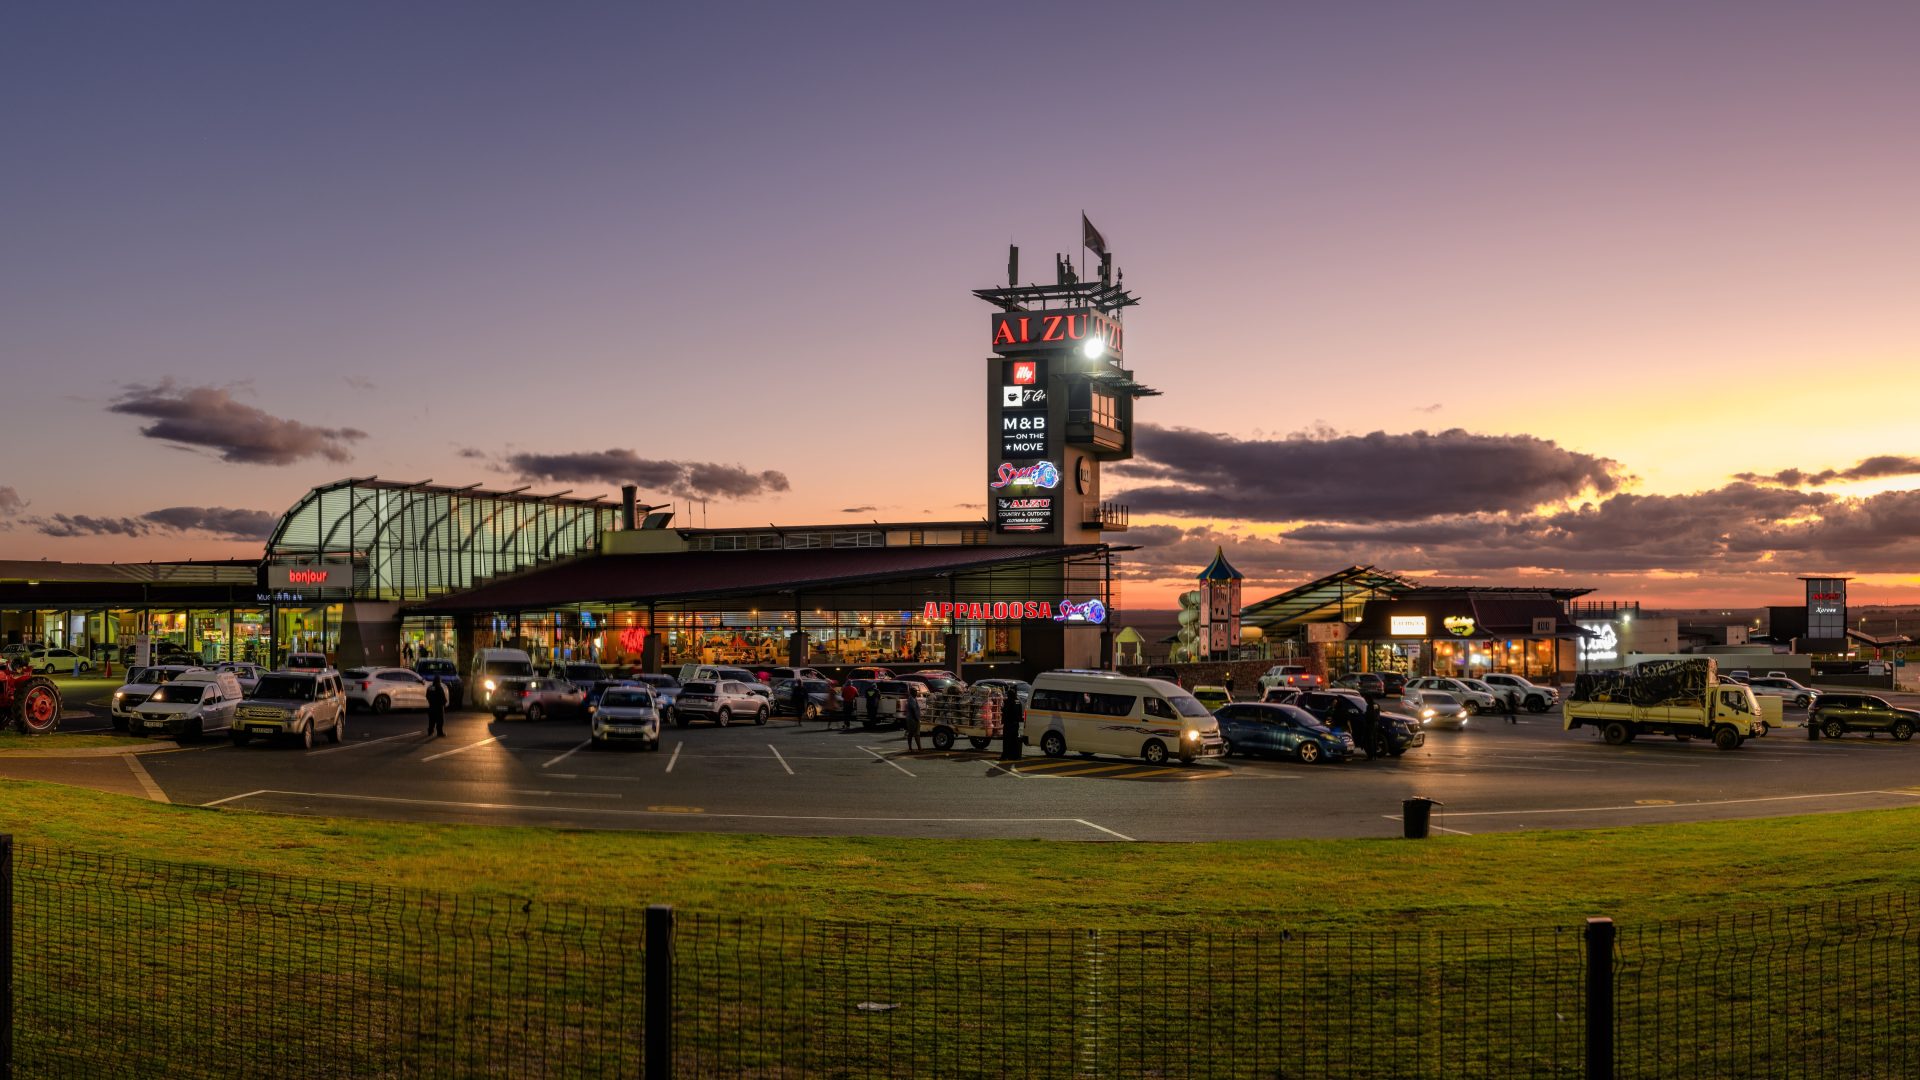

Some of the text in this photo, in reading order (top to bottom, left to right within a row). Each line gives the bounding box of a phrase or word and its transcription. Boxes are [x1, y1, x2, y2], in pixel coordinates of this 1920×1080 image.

[993, 314, 1087, 344] ALZU
[1013, 442, 1044, 451] MOVE
[1010, 498, 1051, 509] ALZU
[289, 569, 328, 585] bonjour
[923, 600, 1053, 620] APPALOOSA
